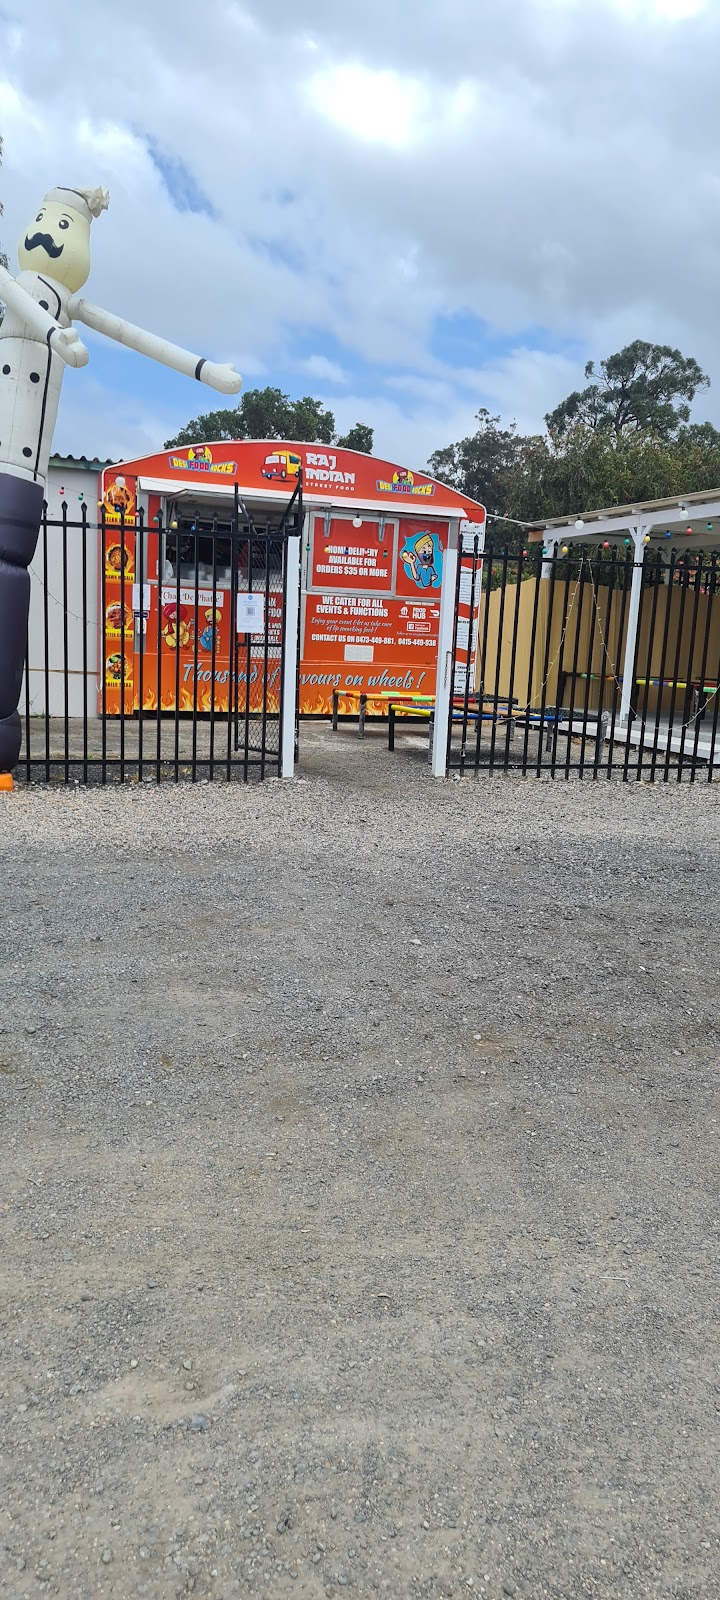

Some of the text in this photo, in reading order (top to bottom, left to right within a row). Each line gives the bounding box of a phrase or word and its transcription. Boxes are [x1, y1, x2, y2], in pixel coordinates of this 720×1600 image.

[189, 460, 210, 471] FOOD
[305, 452, 337, 470] RAJ
[304, 467, 356, 484] INDIAN
[305, 481, 333, 489] STREET
[393, 483, 411, 493] FOOD
[328, 555, 377, 567] AVAILABLE FOR
[316, 564, 388, 578] ORDERS $35 OR MORE
[163, 591, 182, 602] Cha
[322, 595, 384, 608] WE CATER FOR ALL
[316, 604, 389, 617] EVENTS & FUNCTIONS
[311, 617, 326, 625] Enjoy
[311, 633, 337, 642] CONTACT
[347, 635, 355, 643] ON
[183, 662, 259, 684] Thousnd
[261, 666, 282, 689] of
[344, 670, 364, 685] on
[367, 669, 414, 689] wheels
[415, 671, 425, 688] !
